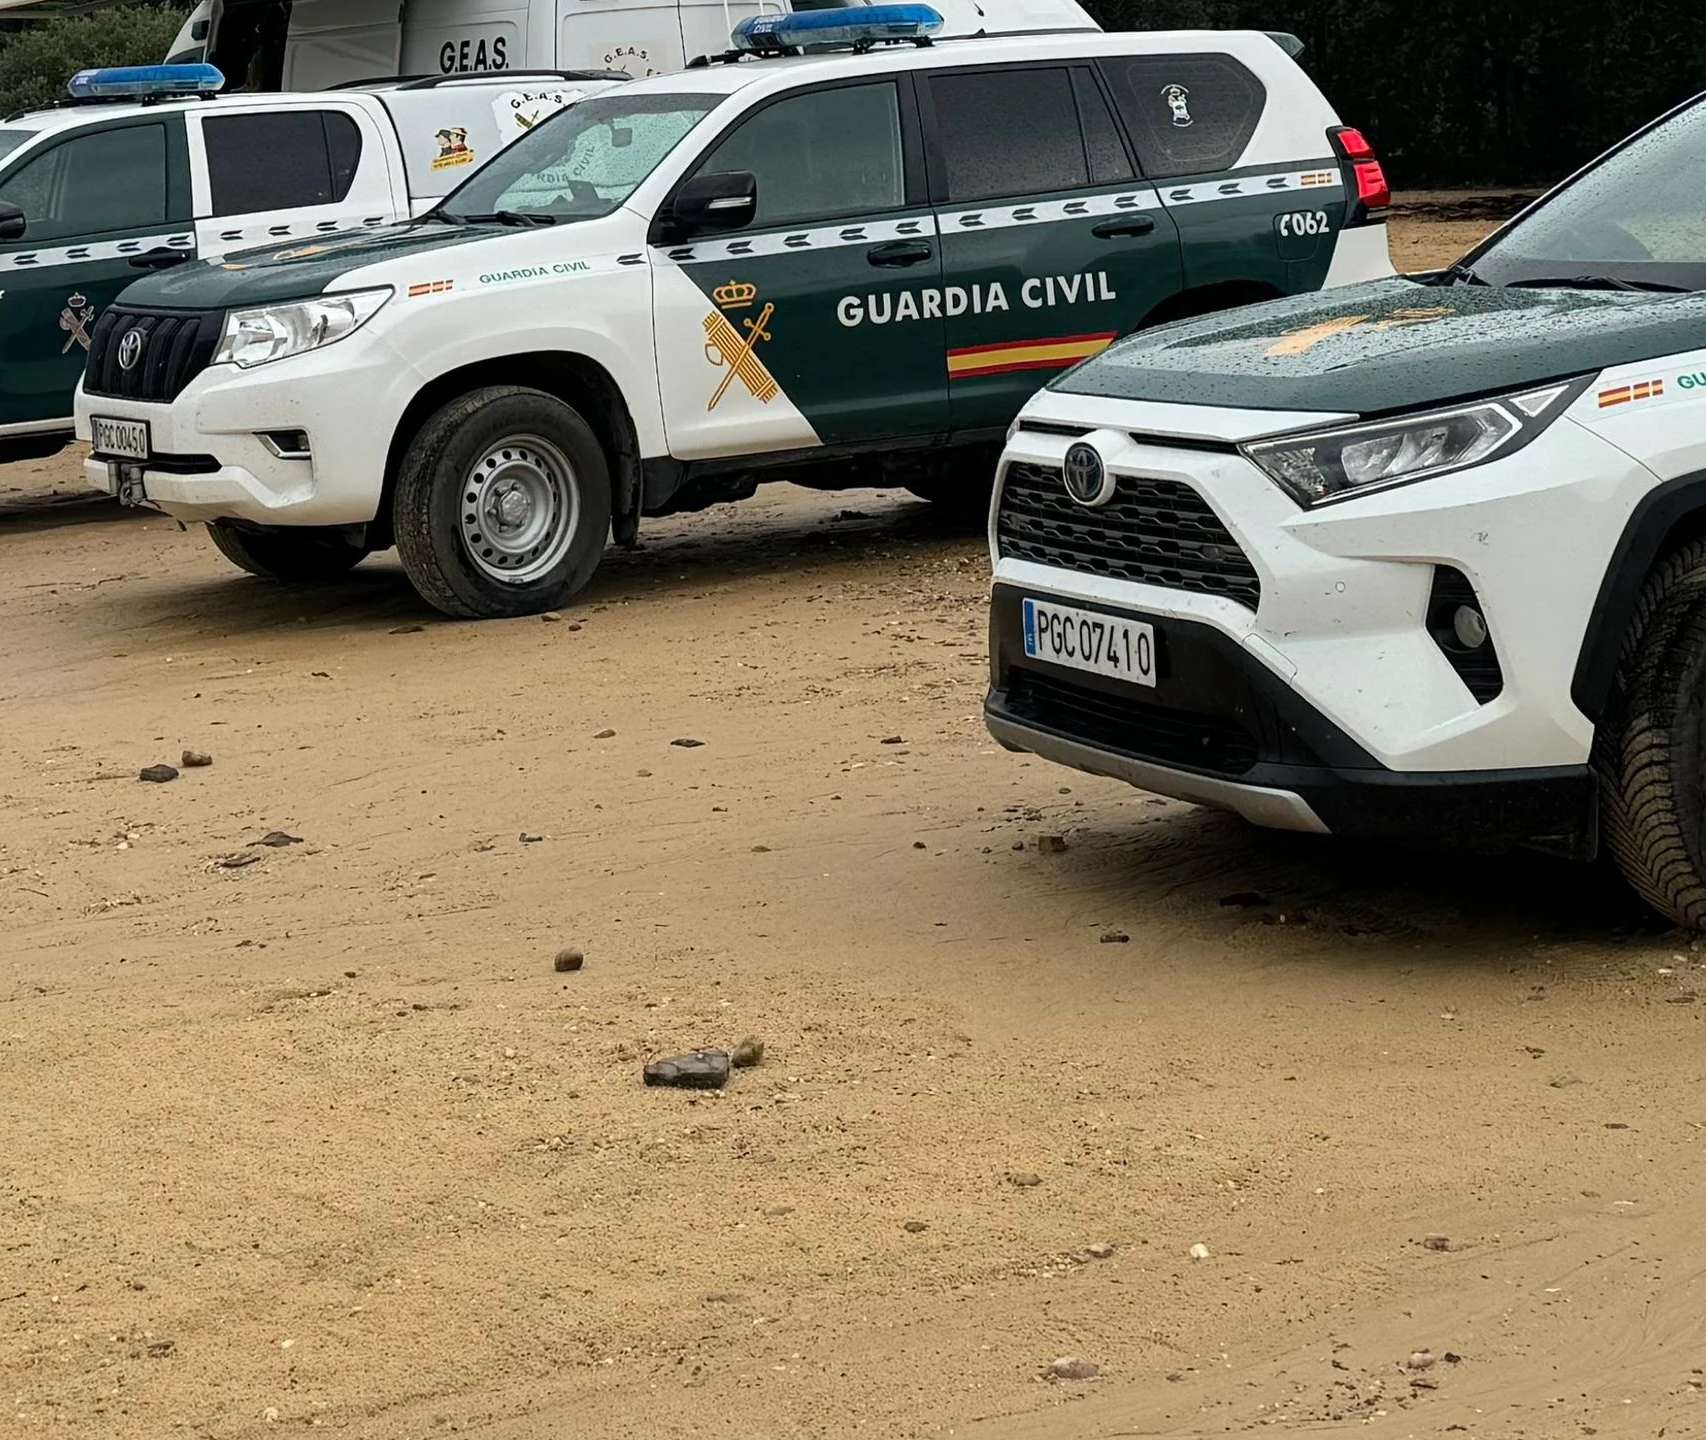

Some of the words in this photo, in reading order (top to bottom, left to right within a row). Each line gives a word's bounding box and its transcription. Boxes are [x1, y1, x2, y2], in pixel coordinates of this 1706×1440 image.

[440, 36, 509, 74] G.E.A.S.
[1292, 210, 1330, 236] 062
[479, 267, 550, 284] GUARDIA
[552, 260, 591, 273] CIVIL
[837, 282, 1010, 327] GUARDIA
[1021, 271, 1117, 309] CIVIL
